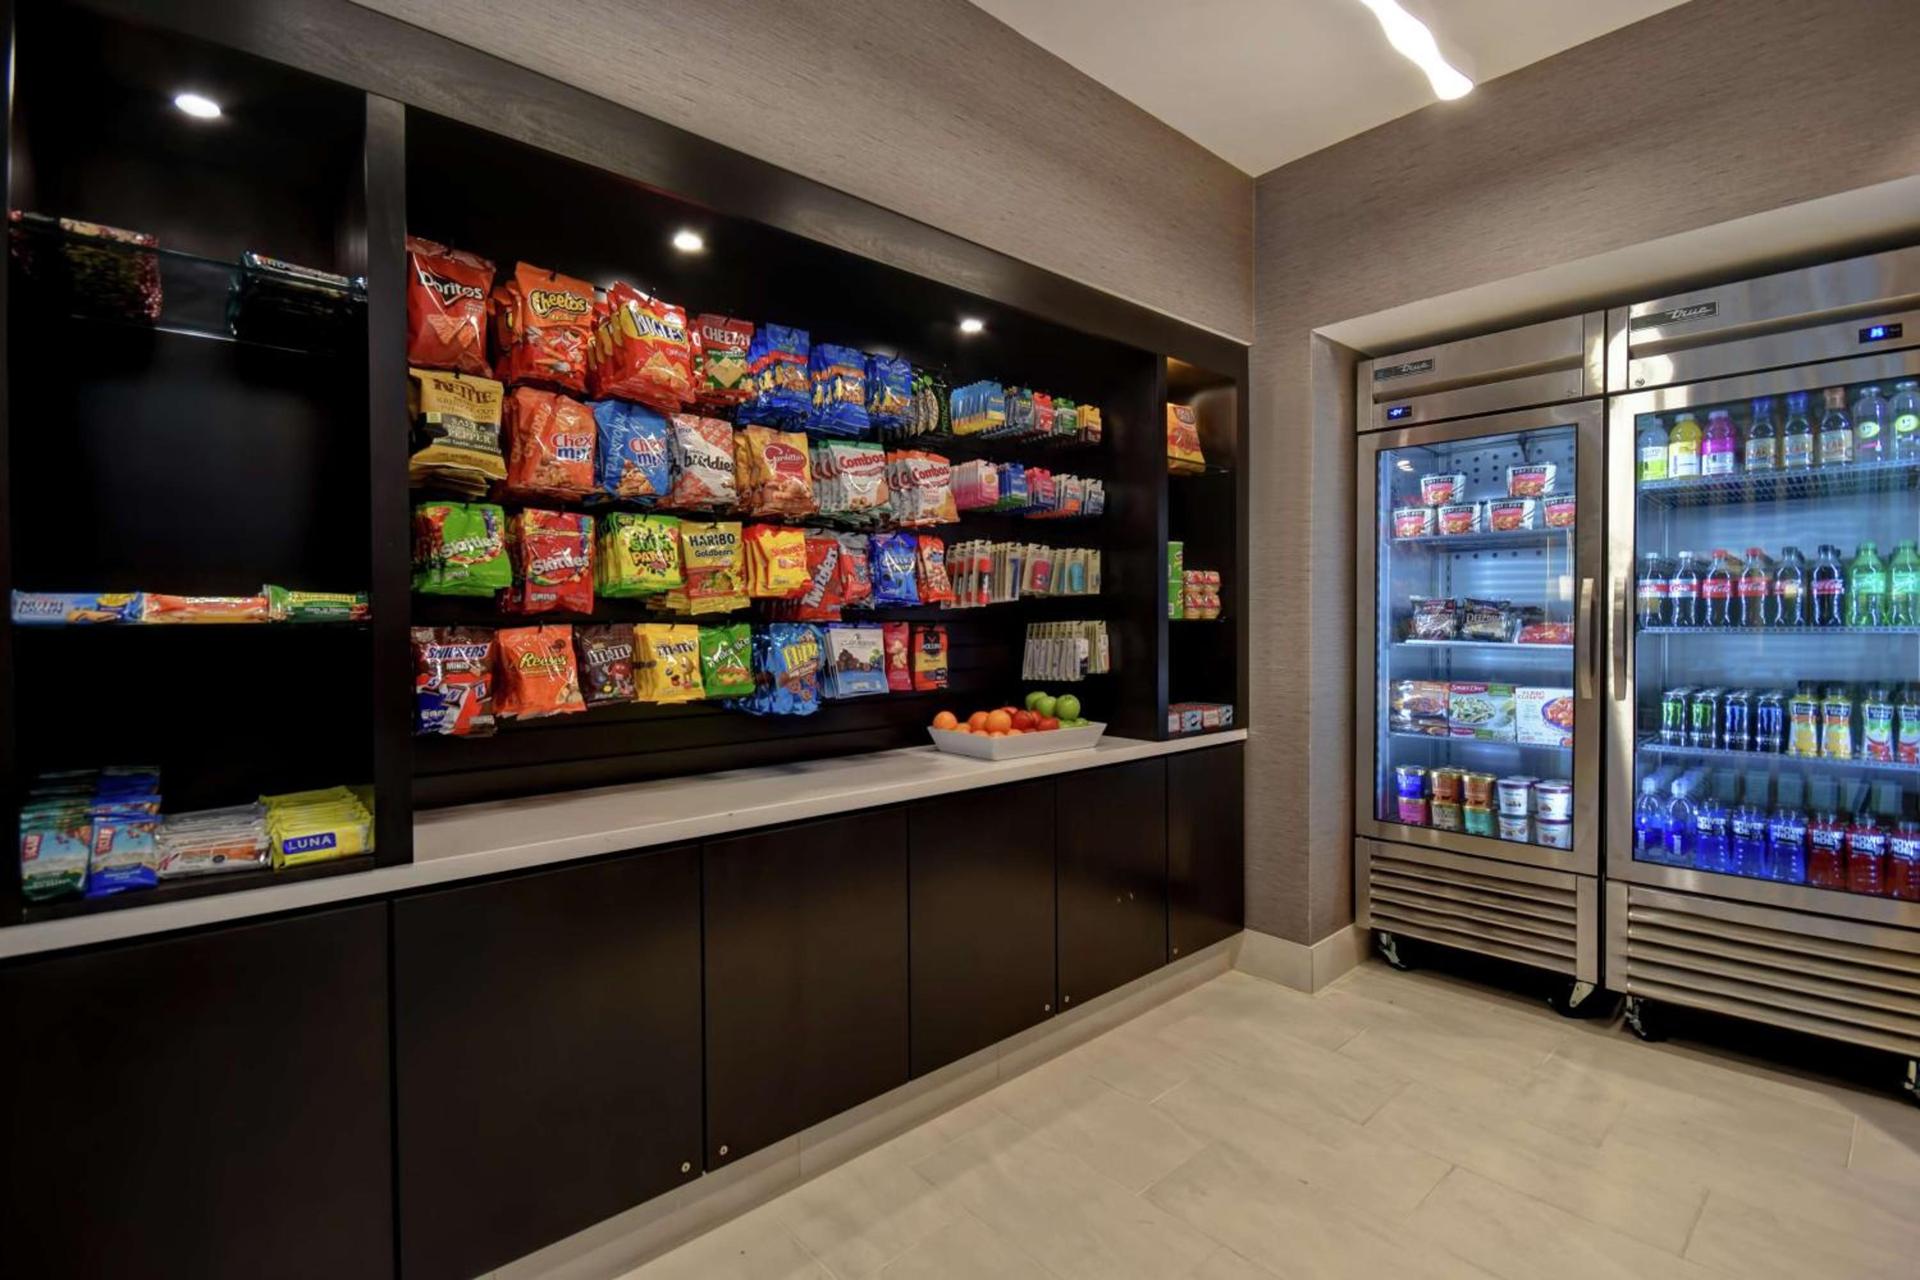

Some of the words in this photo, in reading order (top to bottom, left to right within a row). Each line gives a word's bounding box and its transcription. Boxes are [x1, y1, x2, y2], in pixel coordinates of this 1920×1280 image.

[420, 271, 483, 299] Doritos
[531, 291, 587, 313] Cheetos
[552, 433, 593, 447] Chex
[839, 453, 886, 470] Combos
[689, 533, 736, 547] HARIBO
[429, 645, 488, 658] SNICKERS
[287, 836, 333, 850] LUNA
